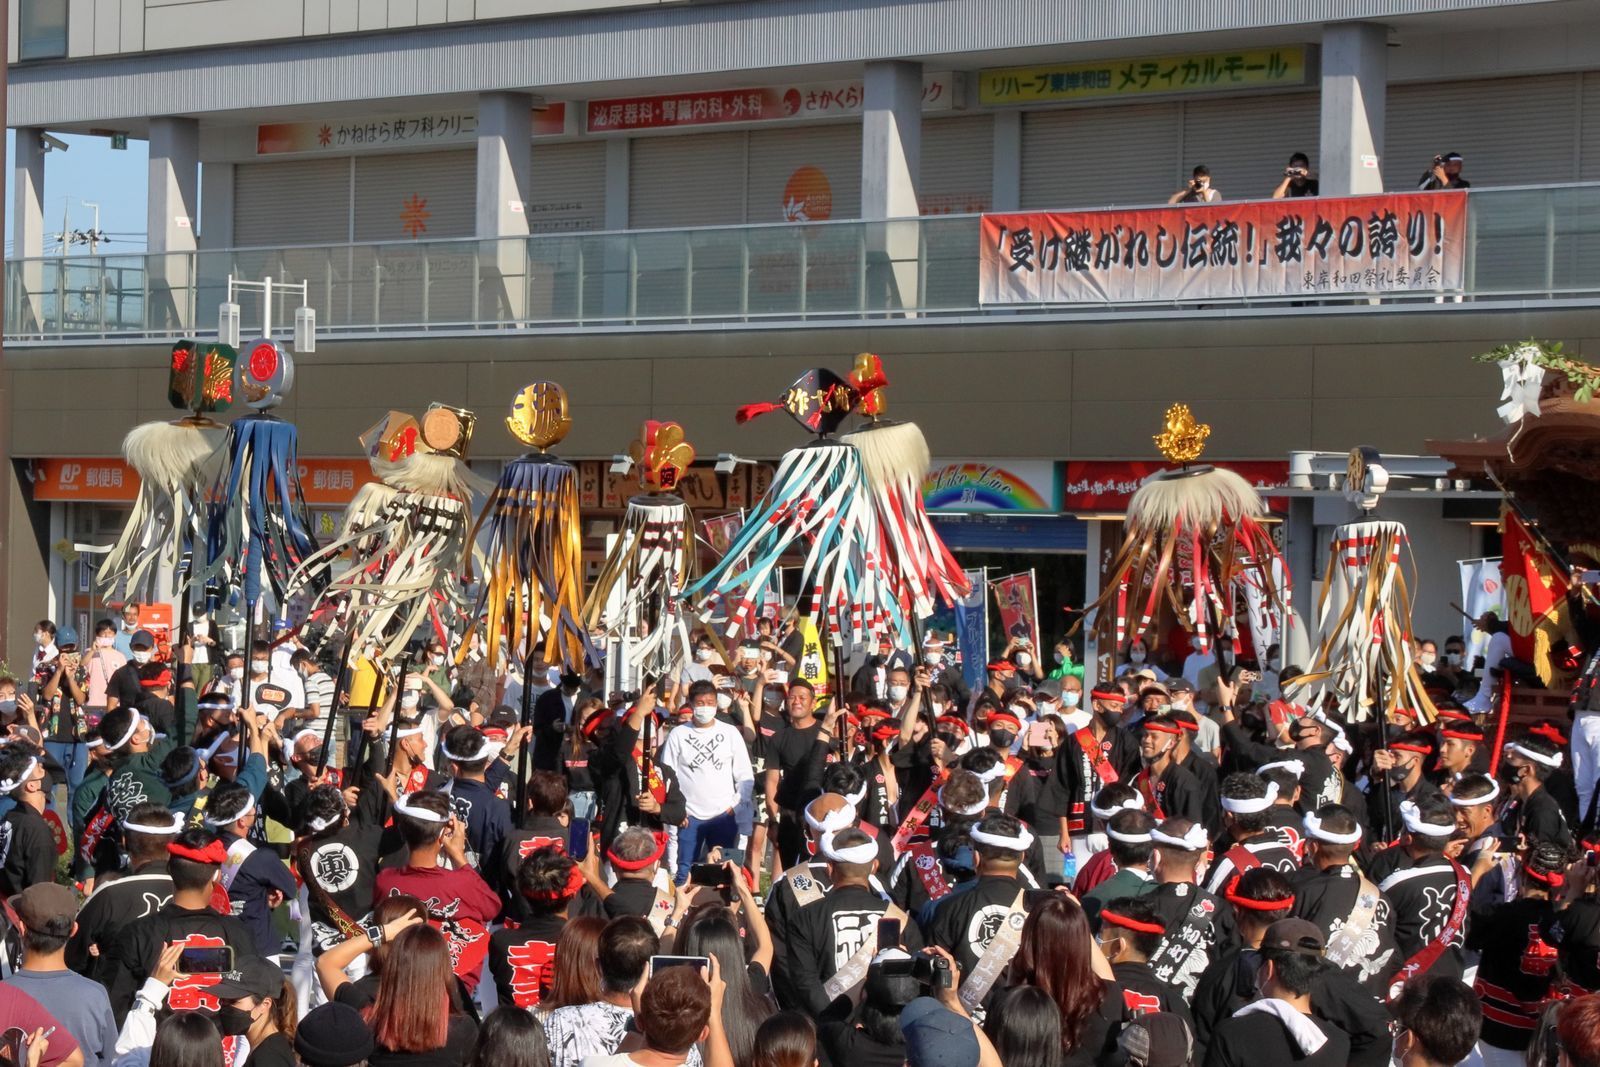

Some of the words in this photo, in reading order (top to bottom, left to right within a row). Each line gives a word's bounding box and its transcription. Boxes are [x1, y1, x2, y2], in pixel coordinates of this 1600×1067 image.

[1118, 52, 1288, 91] メディカルモール
[336, 114, 479, 146] かねはら皮フ科クリニ
[1302, 267, 1442, 290] 東岸和田祭礼委員会
[85, 468, 123, 488] 郵便局
[313, 469, 354, 490] 郵便局
[687, 733, 725, 773] KENZO
